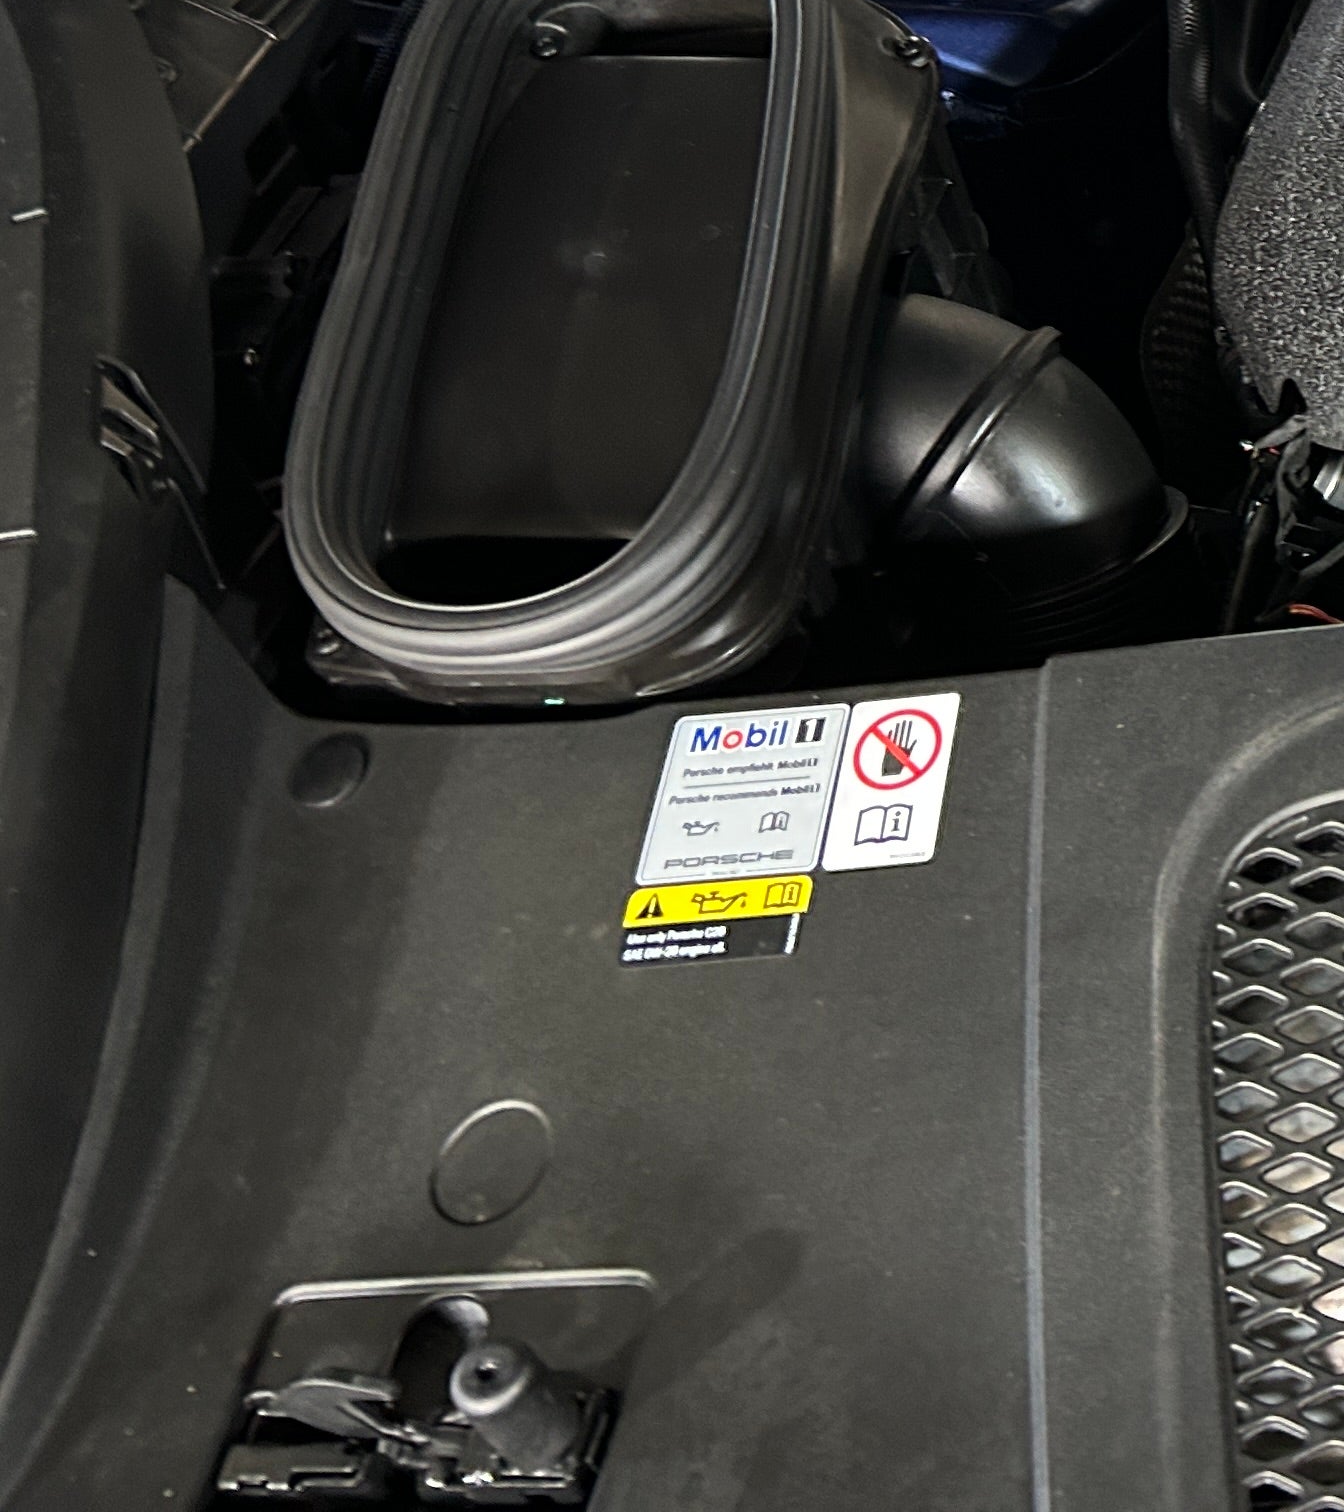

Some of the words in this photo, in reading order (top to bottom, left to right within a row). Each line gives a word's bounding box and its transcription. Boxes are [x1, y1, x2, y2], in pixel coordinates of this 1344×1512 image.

[690, 720, 788, 752] Mobil
[683, 766, 724, 778] Porsche
[668, 794, 710, 805] Porsche
[664, 849, 794, 870] PORSCHE
